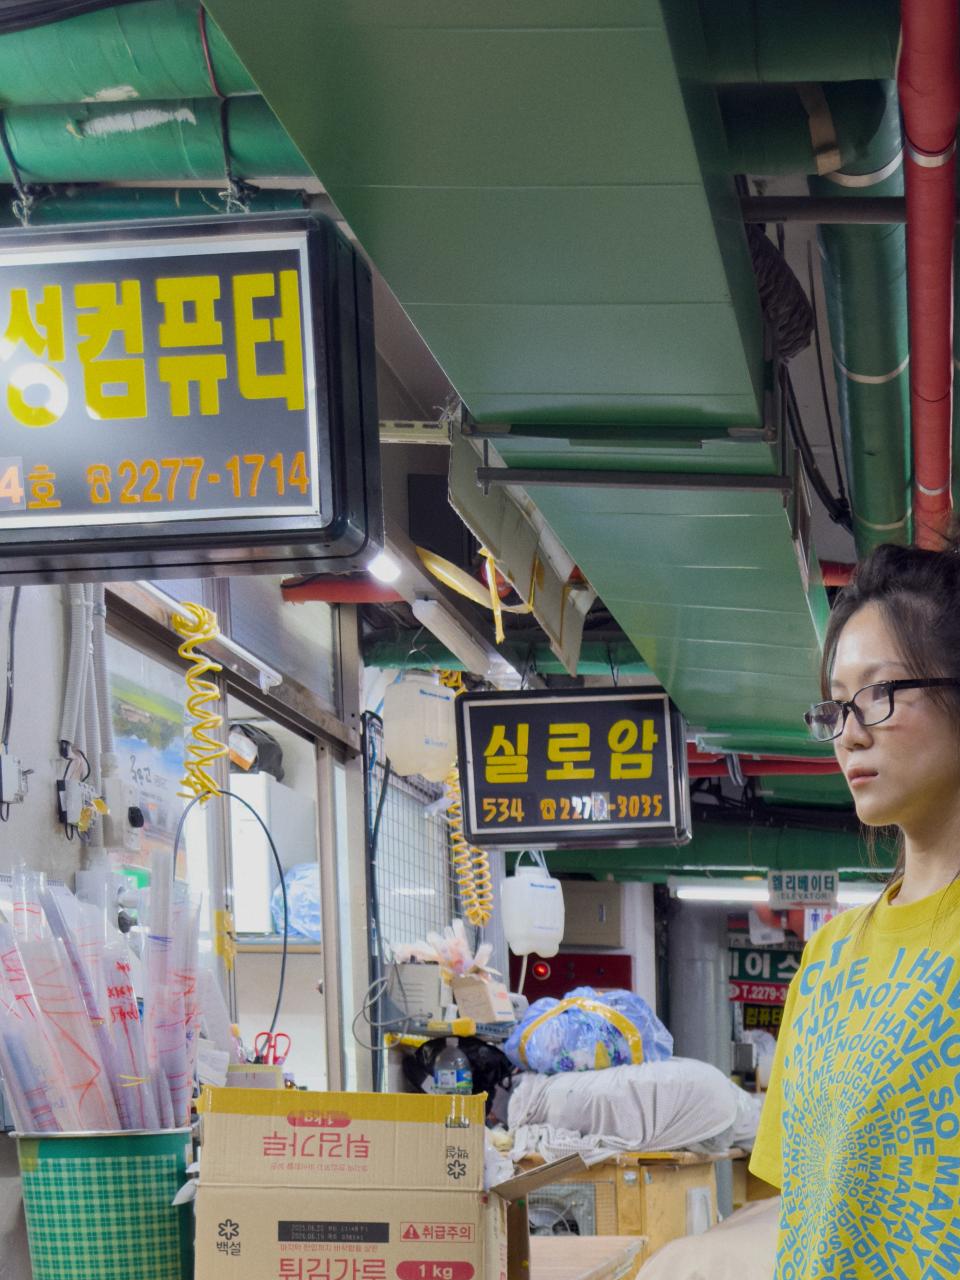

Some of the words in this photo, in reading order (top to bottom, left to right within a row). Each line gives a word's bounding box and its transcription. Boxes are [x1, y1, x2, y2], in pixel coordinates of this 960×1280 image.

[0, 270, 305, 428] 성컴퓨터
[118, 451, 309, 504] 2277-1714
[483, 719, 659, 784] 실로암
[482, 797, 525, 823] 534
[848, 981, 910, 1013] NOT
[874, 1012, 941, 1080] HAVE
[871, 1100, 896, 1156] TIME
[890, 1107, 911, 1144] SO
[898, 1074, 935, 1156] TIME
[928, 1086, 960, 1139] SO
[262, 1130, 372, 1159] 튀김가루
[880, 1156, 913, 1234] MANY
[911, 1156, 960, 1269] MANY
[216, 1241, 241, 1256] 백설
[422, 1225, 471, 1240] 취급주의
[864, 1201, 924, 1277] HAVE
[418, 1264, 426, 1278] 1
[433, 1264, 453, 1279] kg
